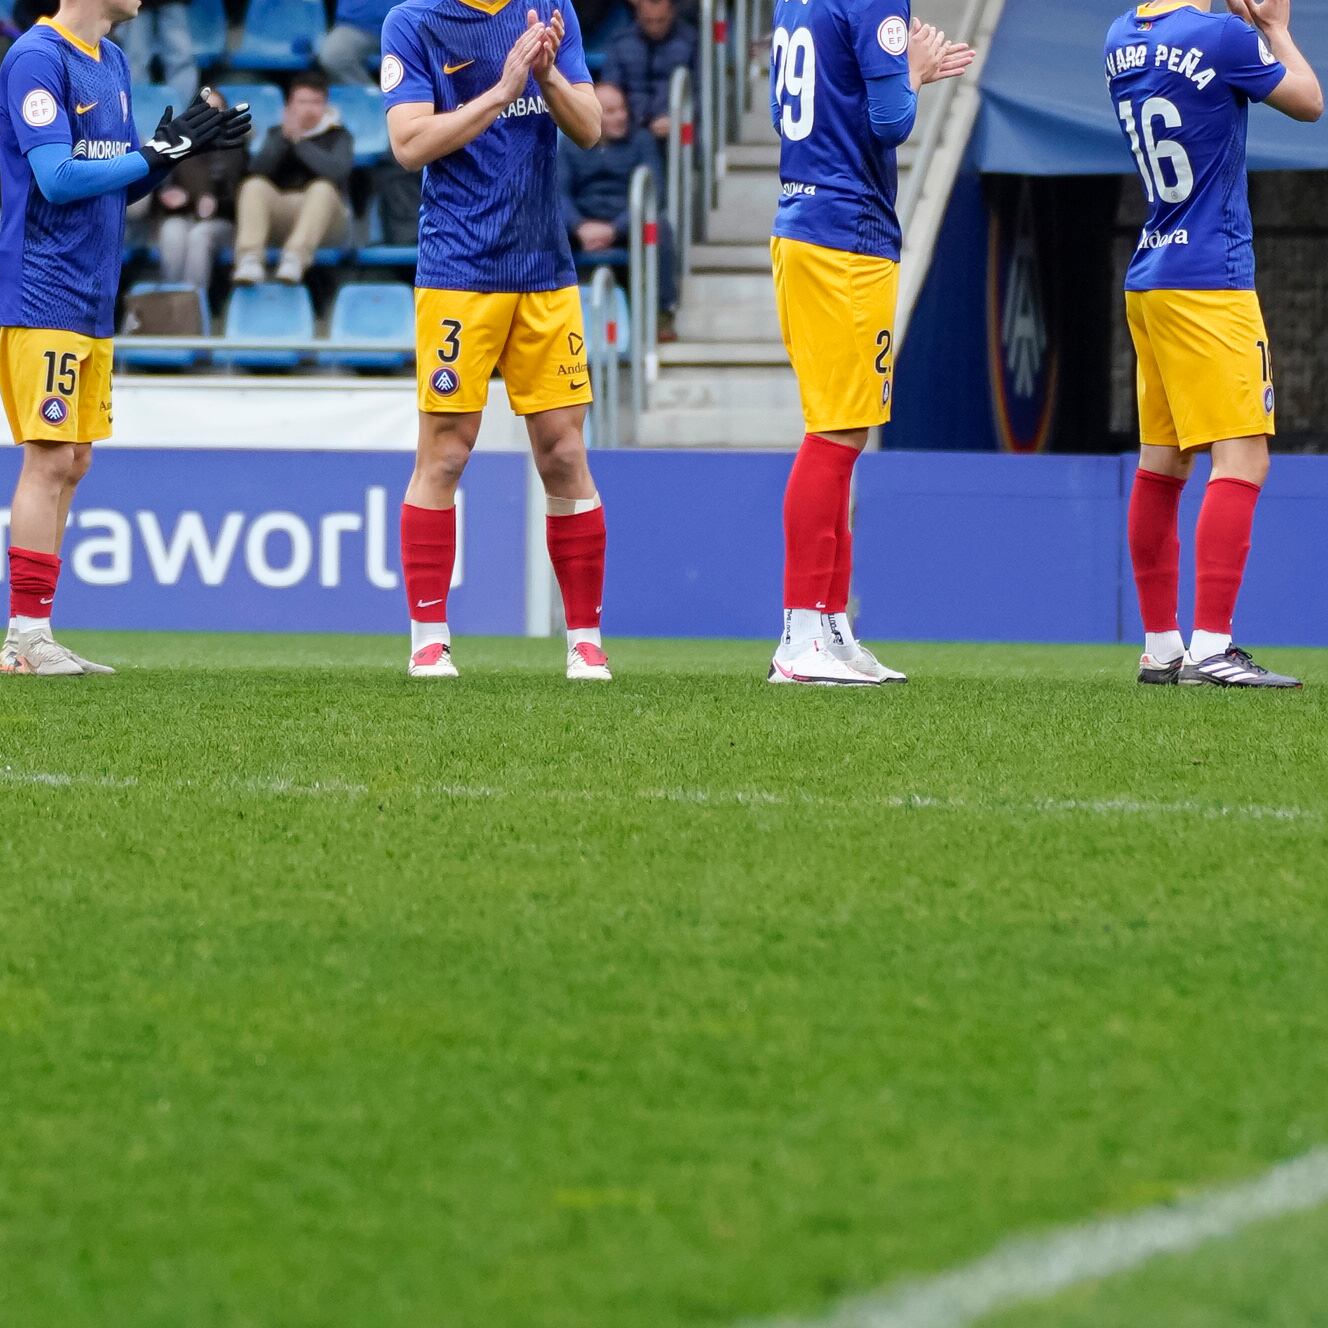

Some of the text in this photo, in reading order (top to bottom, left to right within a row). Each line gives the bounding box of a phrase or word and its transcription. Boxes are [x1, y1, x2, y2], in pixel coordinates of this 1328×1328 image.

[1154, 43, 1217, 91] PEÑA
[1118, 96, 1194, 204] 16
[437, 319, 462, 363] 3
[875, 329, 891, 373] 2
[1256, 340, 1273, 383] 1
[43, 350, 78, 396] 15
